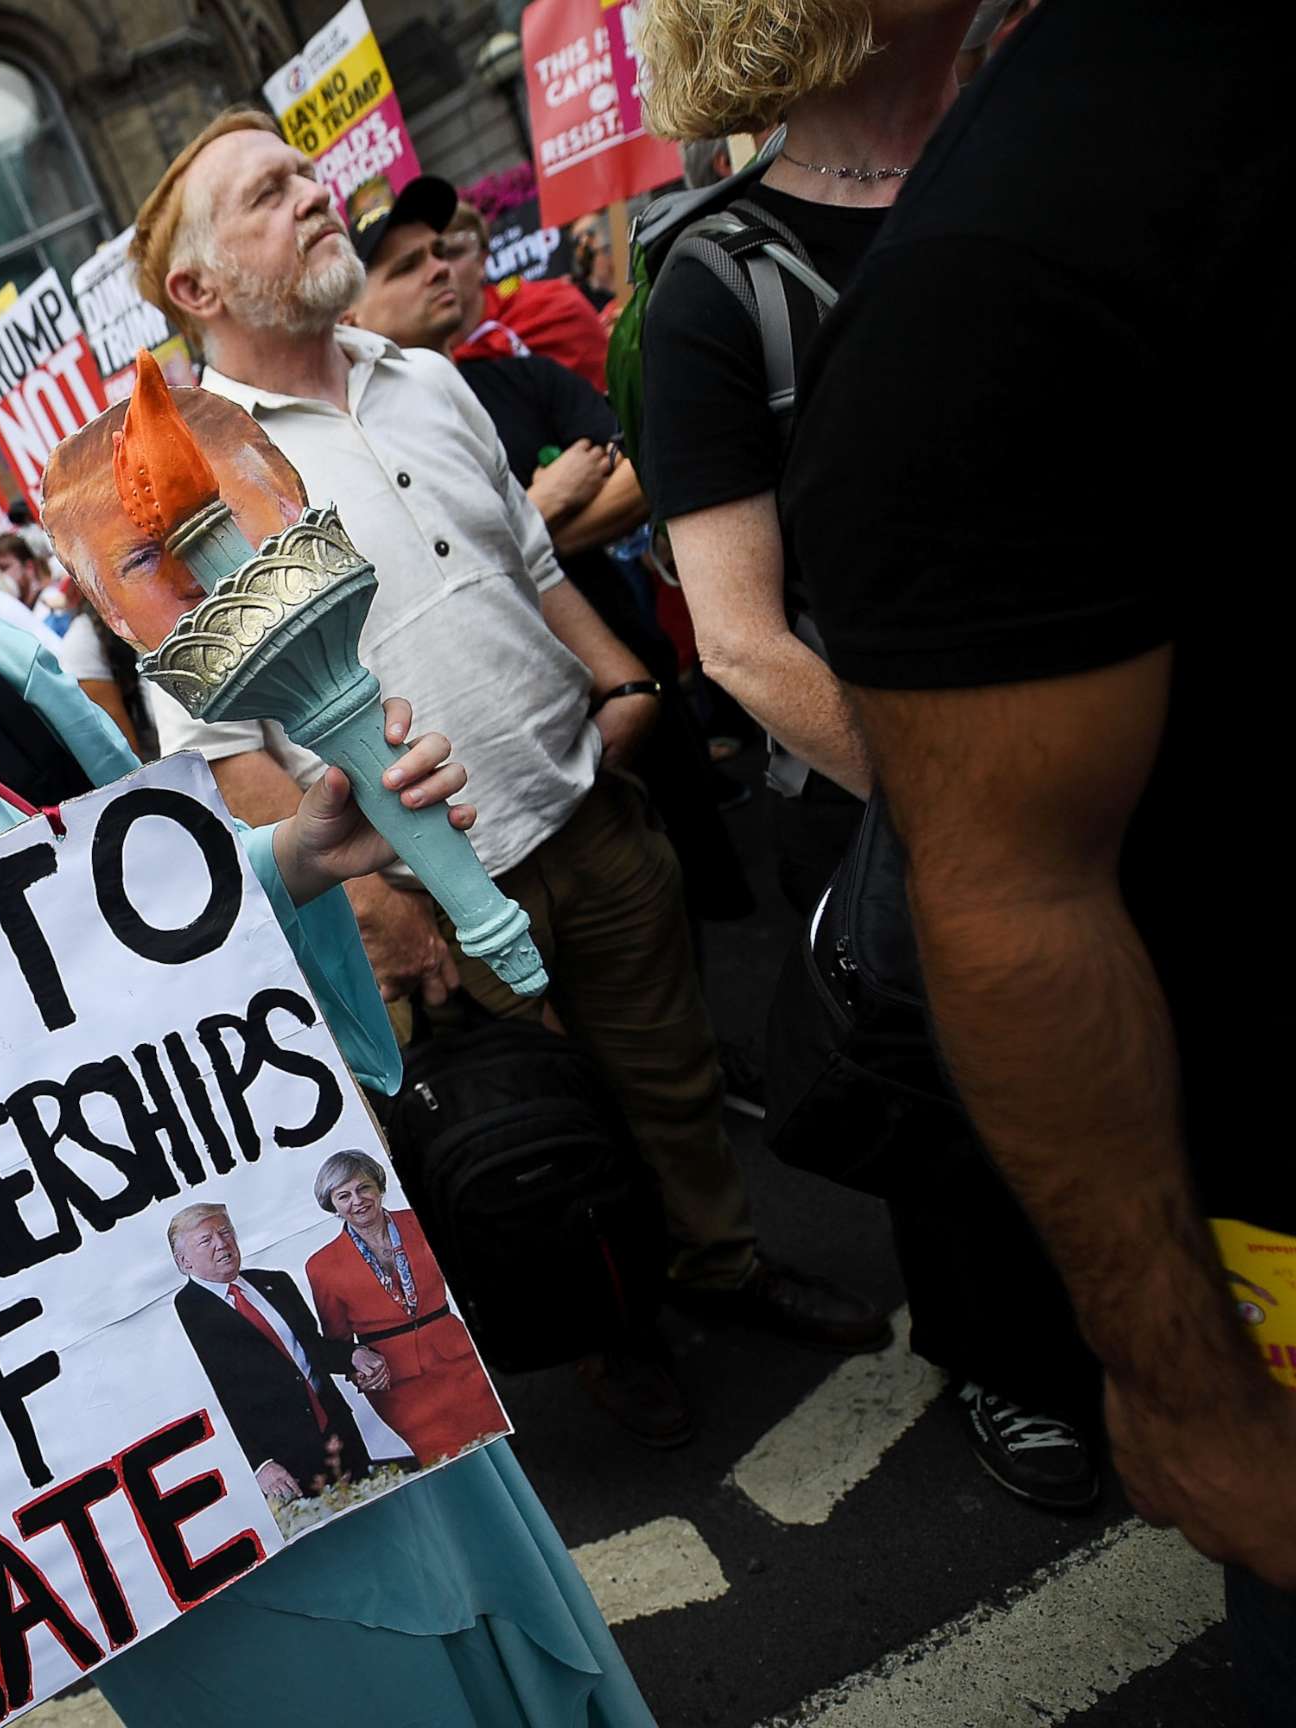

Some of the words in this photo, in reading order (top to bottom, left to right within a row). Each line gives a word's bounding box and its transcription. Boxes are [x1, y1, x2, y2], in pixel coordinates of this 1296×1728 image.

[534, 36, 589, 85] THIS
[320, 70, 347, 105] NO
[320, 69, 382, 135] TRUMP
